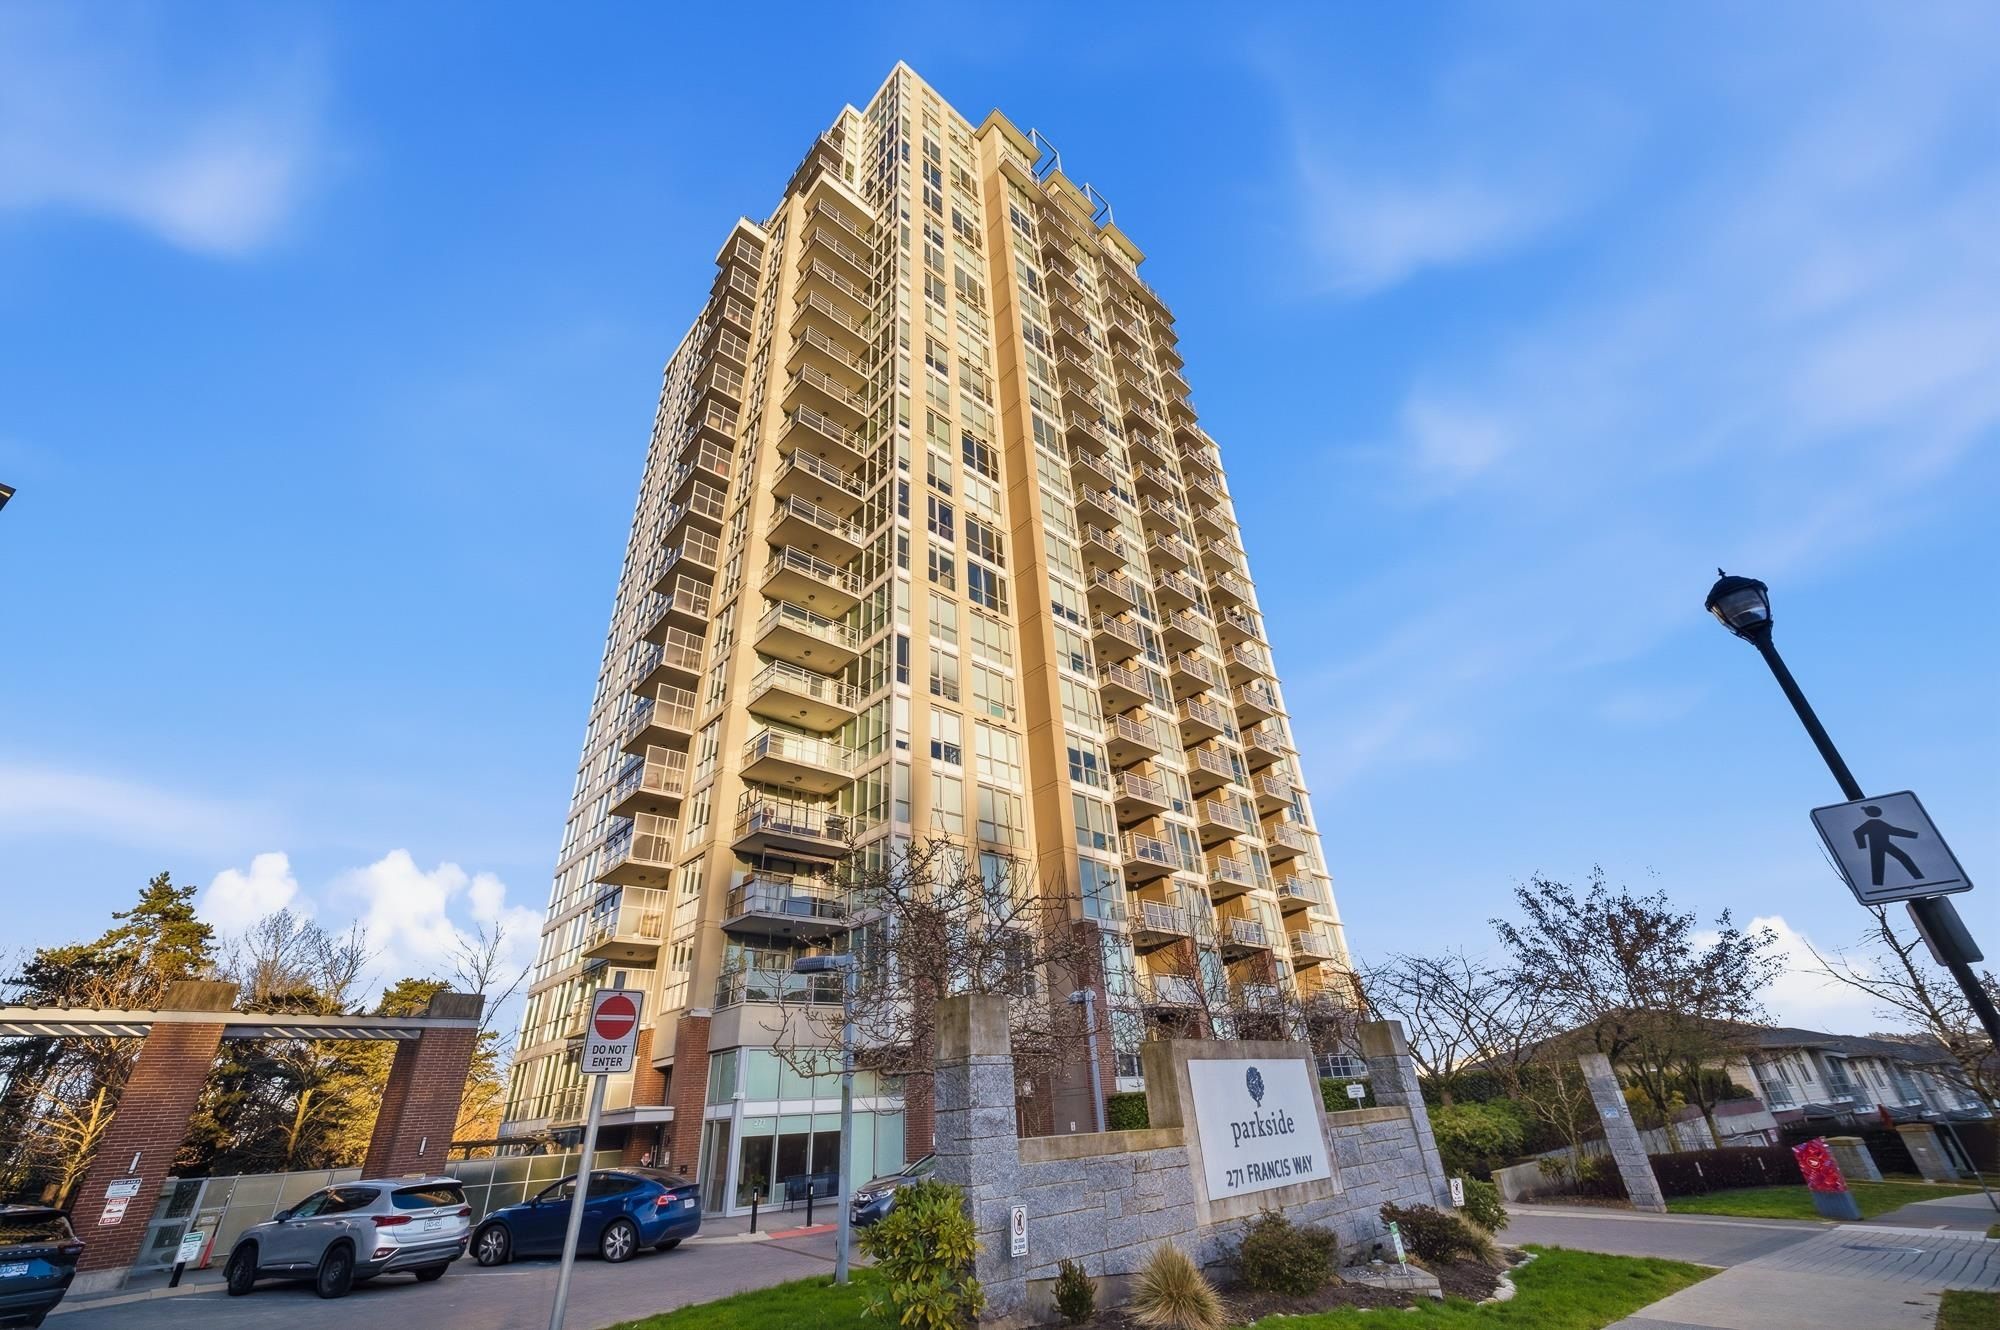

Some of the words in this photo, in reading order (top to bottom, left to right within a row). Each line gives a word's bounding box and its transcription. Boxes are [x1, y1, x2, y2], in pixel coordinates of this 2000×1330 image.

[592, 1045, 606, 1054] DO
[608, 1045, 627, 1054] NOT
[592, 1057, 623, 1067] ENTER
[1230, 1109, 1295, 1148] parkside
[1226, 1168, 1244, 1188] 271
[1247, 1158, 1291, 1183] FRANCIS
[1292, 1155, 1313, 1175] WAY
